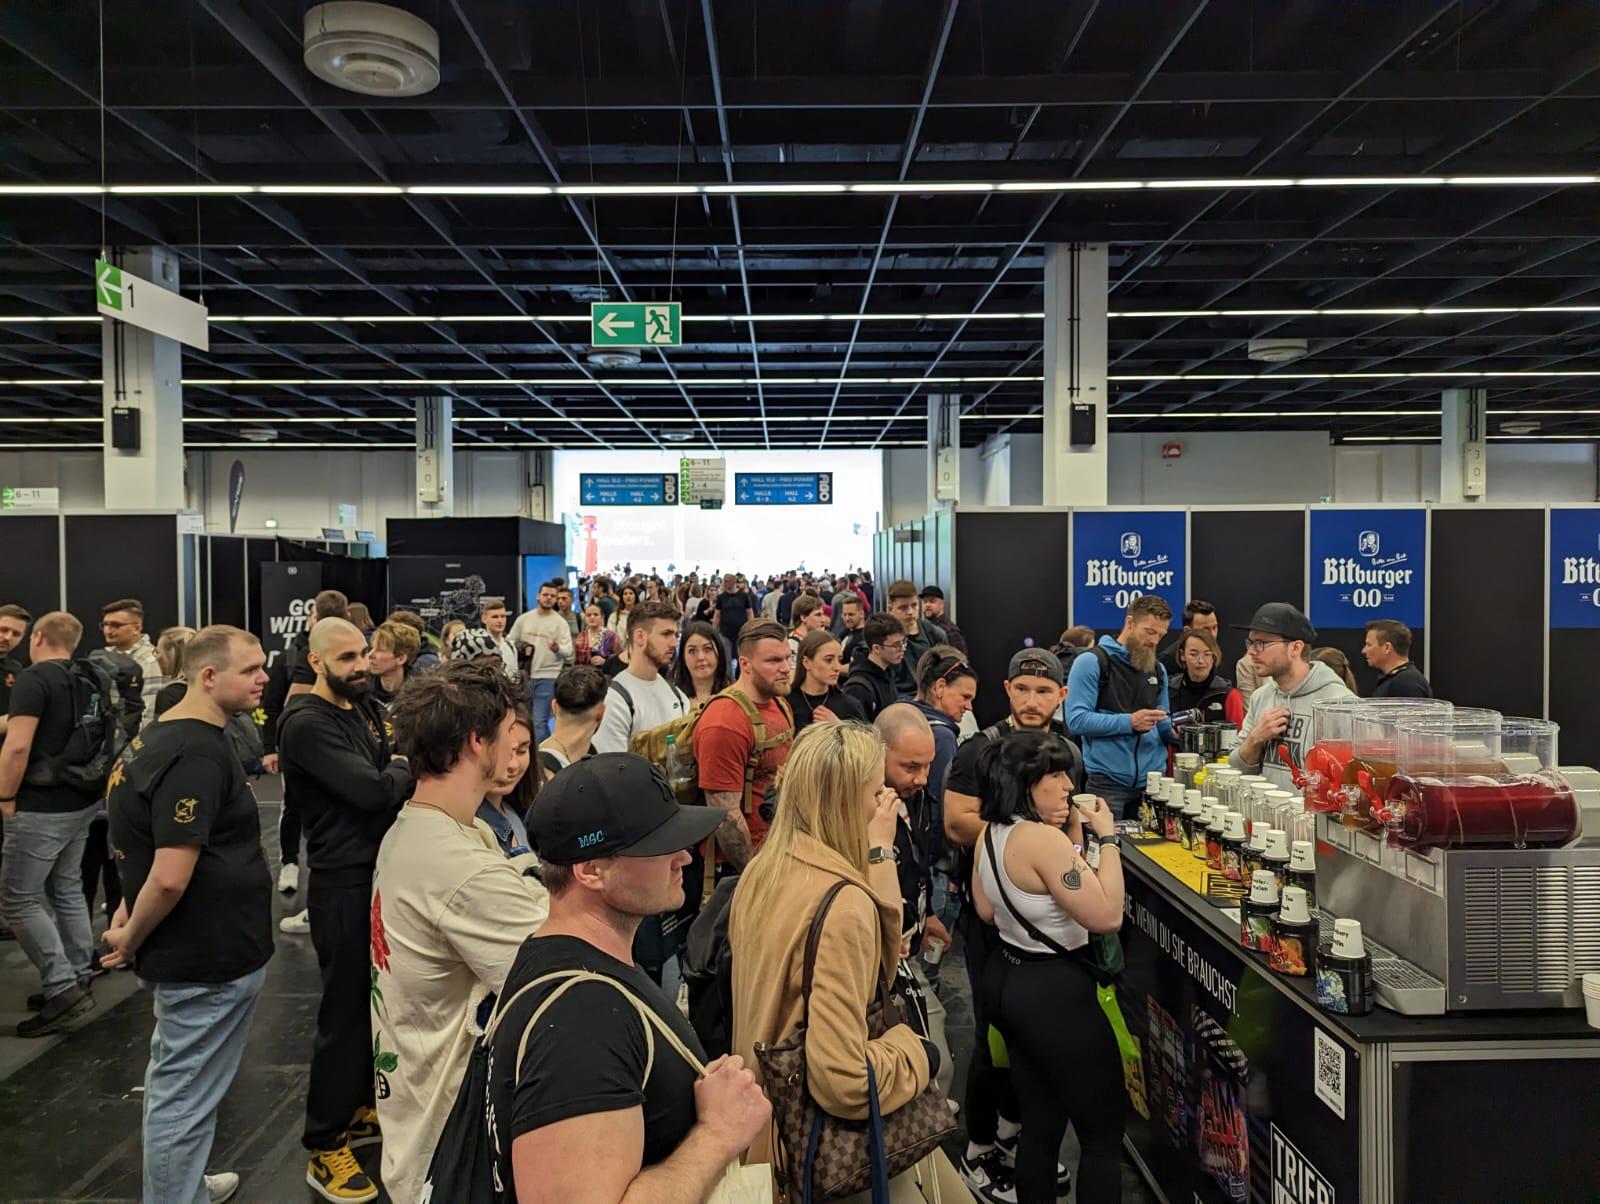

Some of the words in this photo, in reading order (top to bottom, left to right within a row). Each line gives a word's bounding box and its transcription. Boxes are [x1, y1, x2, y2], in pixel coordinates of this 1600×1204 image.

[127, 283, 134, 309] 1
[1085, 559, 1174, 590] Bitburger
[1322, 557, 1413, 589] Bitburger
[577, 830, 605, 848] MGC
[1160, 921, 1170, 953] DU
[1172, 933, 1185, 969] SIE
[1187, 945, 1240, 1019] BRAUCHST.
